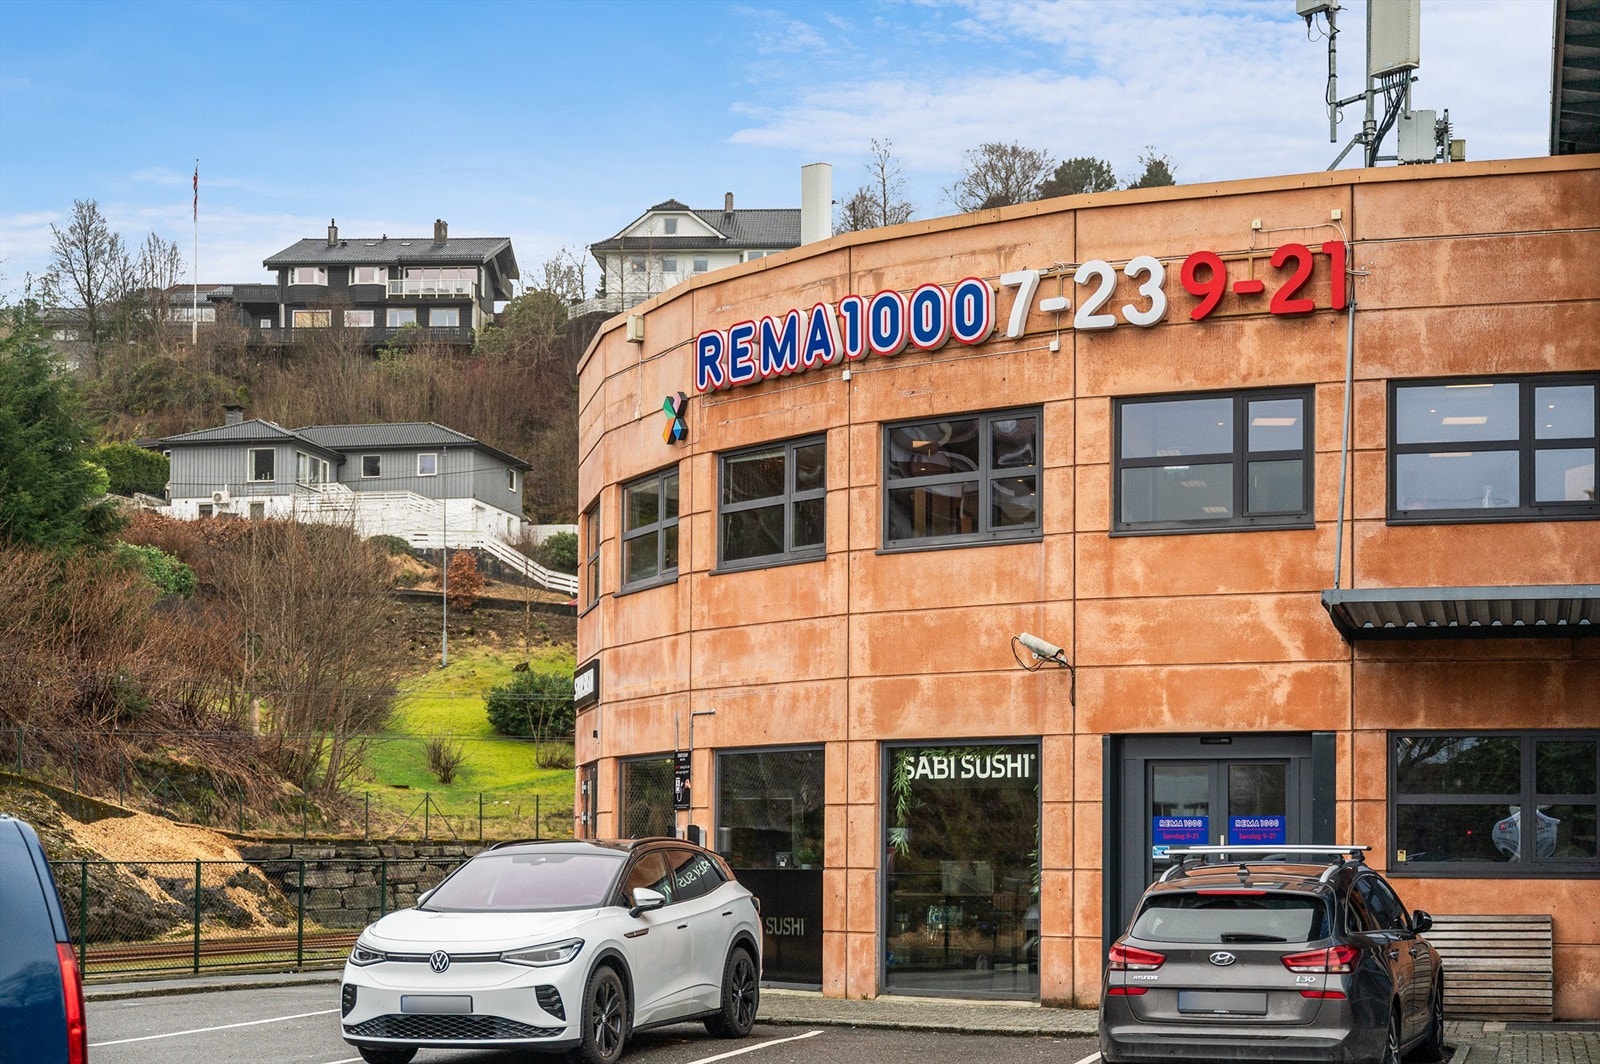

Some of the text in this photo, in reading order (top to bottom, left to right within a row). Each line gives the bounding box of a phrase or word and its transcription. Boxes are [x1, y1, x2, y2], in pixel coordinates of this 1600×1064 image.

[1000, 255, 1168, 339] 7-23
[1180, 241, 1346, 320] 9-21
[903, 753, 1030, 780] SABI SUSHI
[765, 917, 805, 936] SUSHI
